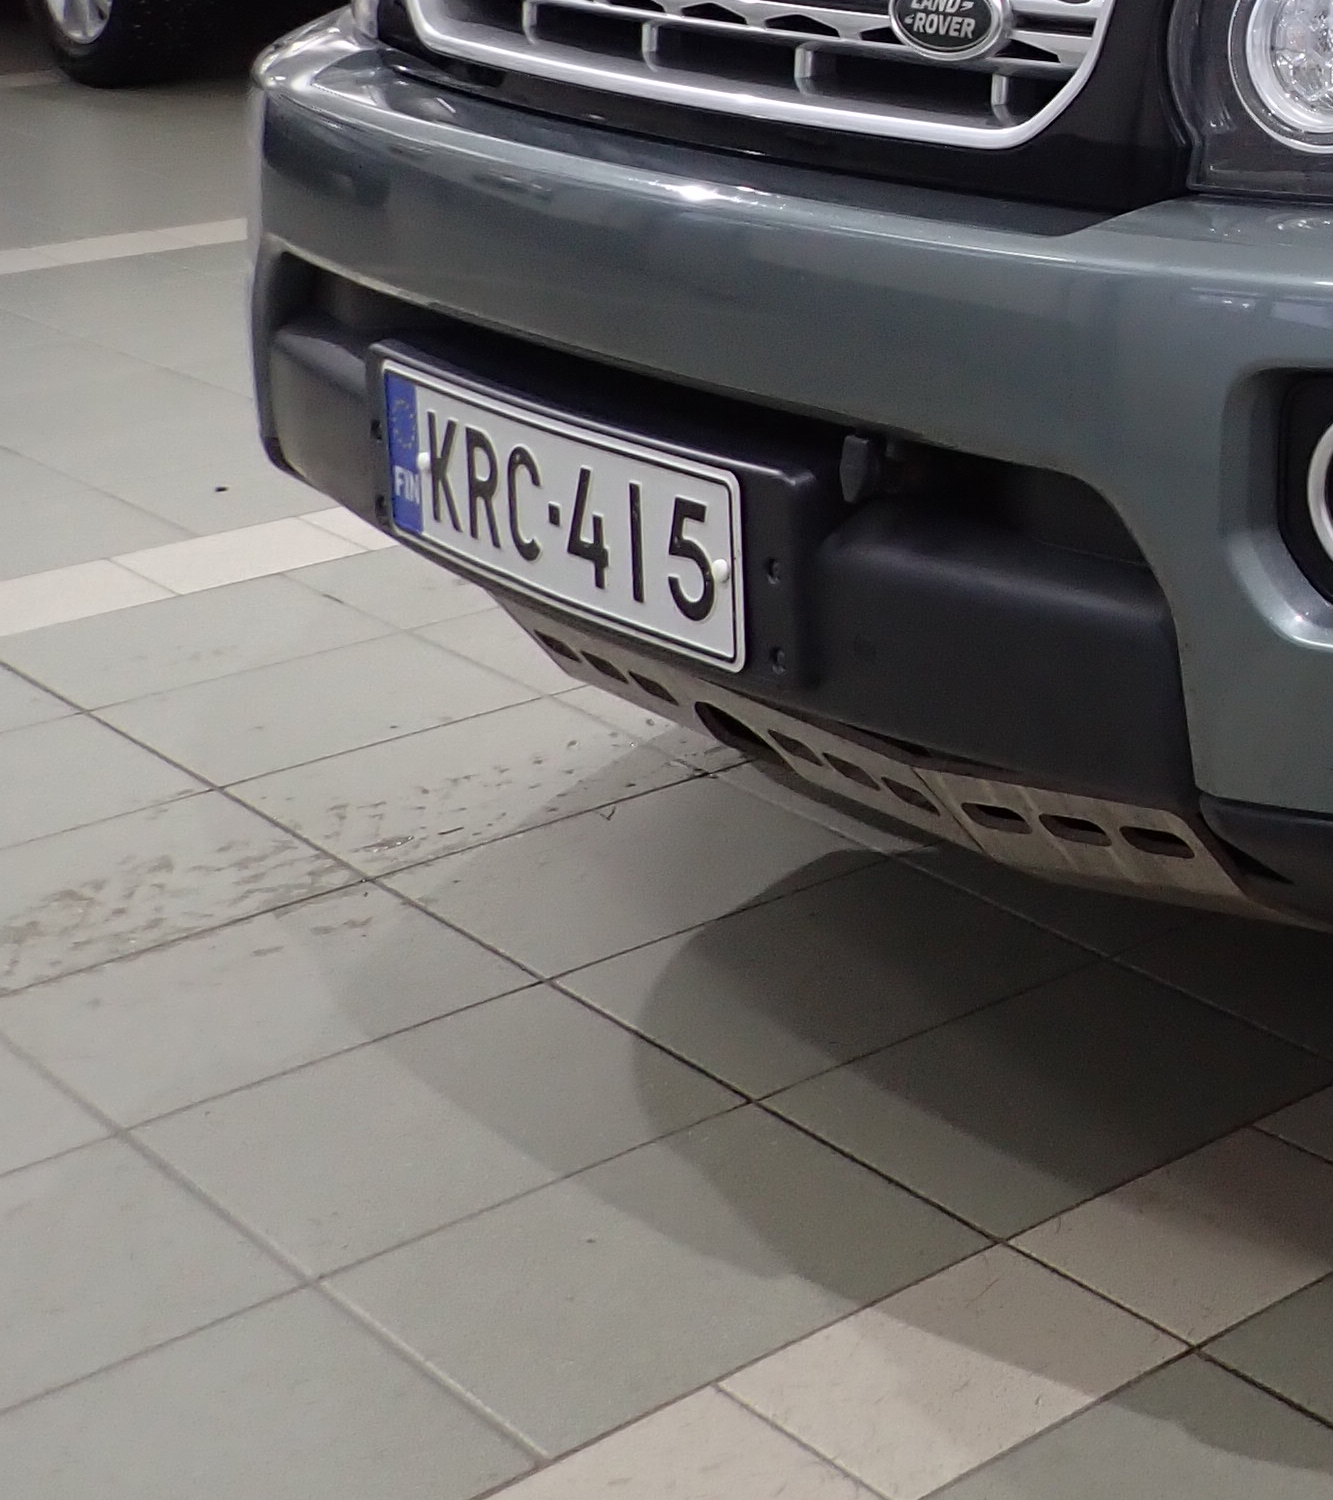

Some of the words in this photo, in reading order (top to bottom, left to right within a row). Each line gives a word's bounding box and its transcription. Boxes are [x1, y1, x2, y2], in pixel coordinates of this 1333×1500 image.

[913, 12, 976, 39] ROVER
[394, 464, 421, 505] FIN
[427, 409, 716, 622] KRC-415
